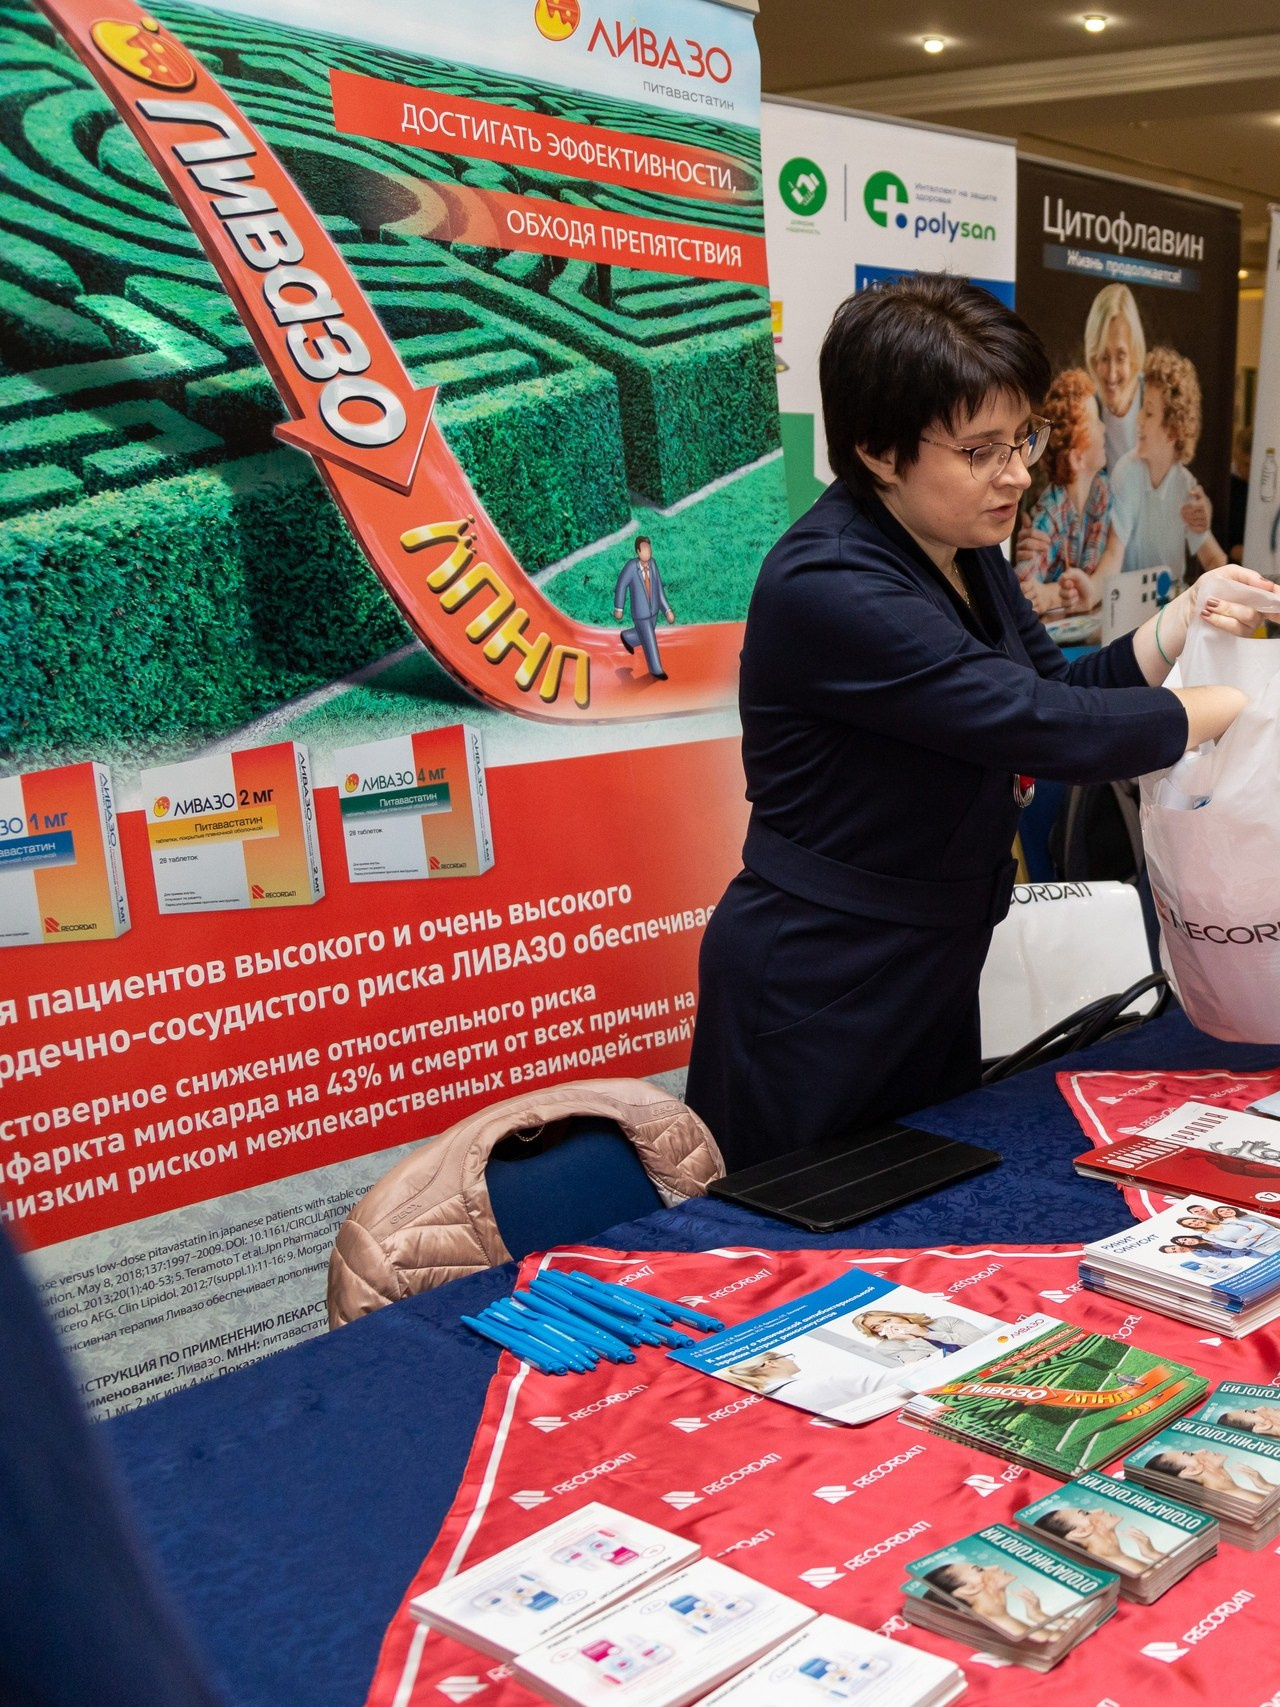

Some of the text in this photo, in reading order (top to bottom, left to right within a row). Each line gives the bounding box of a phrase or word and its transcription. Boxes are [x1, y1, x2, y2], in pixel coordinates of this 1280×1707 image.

[587, 17, 732, 84] ЛИВАЗО
[643, 80, 734, 111] питавастатин
[401, 102, 737, 194] ДОСТИГАТЬ ЭФФЕКТИВНОСТИ,
[506, 209, 597, 250] ОБХОДЯ
[600, 225, 742, 268] ПРЕПЯТСТВИЯ
[914, 211, 996, 243] polysan
[1043, 194, 1204, 261] Цитофлавин
[1066, 249, 1182, 284] Жизнь продолжается!
[361, 767, 446, 792] ЛИВАЗО 4 мг
[379, 792, 438, 808] Питавастатин
[44, 812, 69, 830] мг
[173, 789, 274, 817] ЛИВАЗО 2 мг
[194, 816, 263, 833] Питавастатин
[357, 828, 383, 836] таблеток
[159, 855, 199, 865] 28 таблеток
[265, 891, 297, 899] RECORDATI
[61, 924, 97, 932] RECORDATI
[28, 959, 226, 1020] пациентов
[234, 928, 386, 980] высокого
[393, 923, 412, 948] и
[419, 906, 503, 942] очень
[508, 883, 633, 926] высокого
[358, 932, 566, 1007] риска ЛИВАЗО
[176, 983, 597, 1098] снижение относительного риска
[134, 990, 696, 1148] миокарда на 43% и смерти от всех причин на
[128, 1070, 505, 1194] риском межлекарственных
[1259, 1190, 1280, 1203] 17
[58, 1188, 354, 1286] versus low-dose pitavastatin in japanese patients with stable
[176, 1271, 185, 1282] 5.
[185, 1256, 234, 1279] Teramoto
[235, 1254, 244, 1263] T
[243, 1251, 253, 1261] et
[253, 1246, 265, 1258] al.
[265, 1242, 282, 1256] Jpn
[283, 1226, 333, 1247] Pharmacol
[1101, 1235, 1135, 1250] РИНИТ
[1113, 1233, 1160, 1255] СИНУСИТ
[77, 1282, 101, 1297] May
[103, 1278, 114, 1288] 8,
[226, 1237, 248, 1251] DOI:
[90, 1308, 117, 1325] AFG.
[118, 1302, 140, 1315] Clin
[141, 1289, 179, 1309] Lipidol.
[288, 1250, 297, 1261] 9.
[297, 1240, 334, 1258] Morgan
[708, 1268, 773, 1300] RECORDATI
[948, 1263, 1003, 1293] RECORDATI
[118, 1277, 276, 1336] терапия Ливазо обеспечивает
[714, 1345, 750, 1362] вопросу
[755, 1320, 803, 1344] топической
[801, 1286, 876, 1324] антибактериальной
[1010, 1318, 1045, 1339] ЛИВАЗО
[159, 1318, 275, 1366] ПО ПРИМЕНЕНИЮ
[176, 1339, 261, 1379] Ливазо. МНН:
[714, 1311, 838, 1367] терапии острых риносинуситов
[1023, 1333, 1087, 1368] ОБХОДЯ ПРЕПЯТСТВИЯ
[989, 1352, 1024, 1373] ДОСТИГАТЬ
[568, 1384, 649, 1421] RECORDATI
[551, 1452, 638, 1496] RECORDATI
[702, 1452, 783, 1496] RECORDATI
[853, 1444, 927, 1489] RECORDATI
[1076, 1473, 1202, 1530] ОТОЛАРИНГОЛОГИЯ
[842, 1520, 933, 1571] RECORDATI
[978, 1526, 1099, 1594] ОТОЛАРИНГОЛОГИЯ
[1181, 1589, 1256, 1646] RECORDATI
